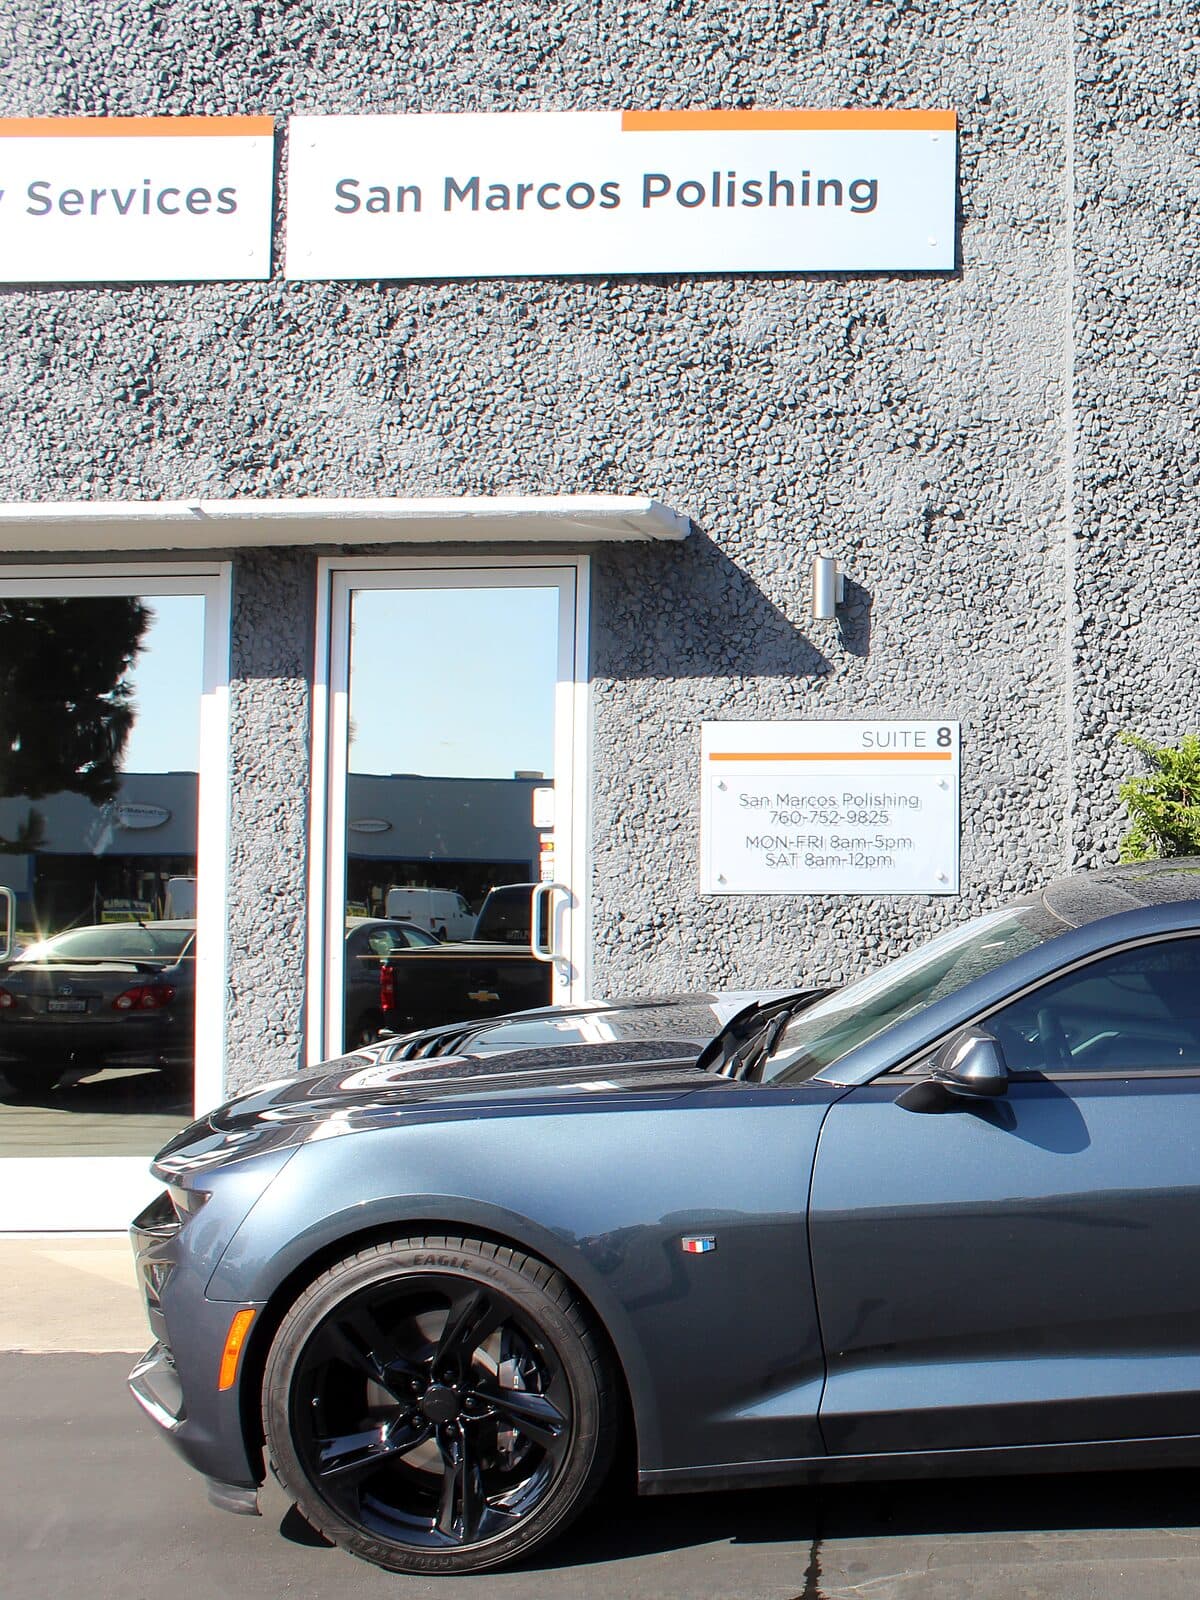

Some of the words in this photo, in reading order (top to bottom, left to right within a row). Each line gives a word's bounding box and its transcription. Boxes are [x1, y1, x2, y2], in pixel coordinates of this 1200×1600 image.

[26, 179, 238, 216] Services
[334, 178, 422, 214] San
[444, 176, 621, 212] Marcos
[642, 171, 880, 214] Polishing
[861, 730, 927, 748] SUITE
[936, 726, 953, 748] 8
[739, 793, 770, 808] San
[776, 793, 837, 807] Marcos
[842, 792, 920, 809] Polishing
[769, 810, 890, 825] 760-752-9825
[745, 835, 824, 849] MON-FRI
[829, 834, 913, 851] 8am-5pm
[765, 852, 798, 867] SAT
[804, 852, 893, 869] 8am-12pm
[413, 1254, 473, 1270] EAGLE
